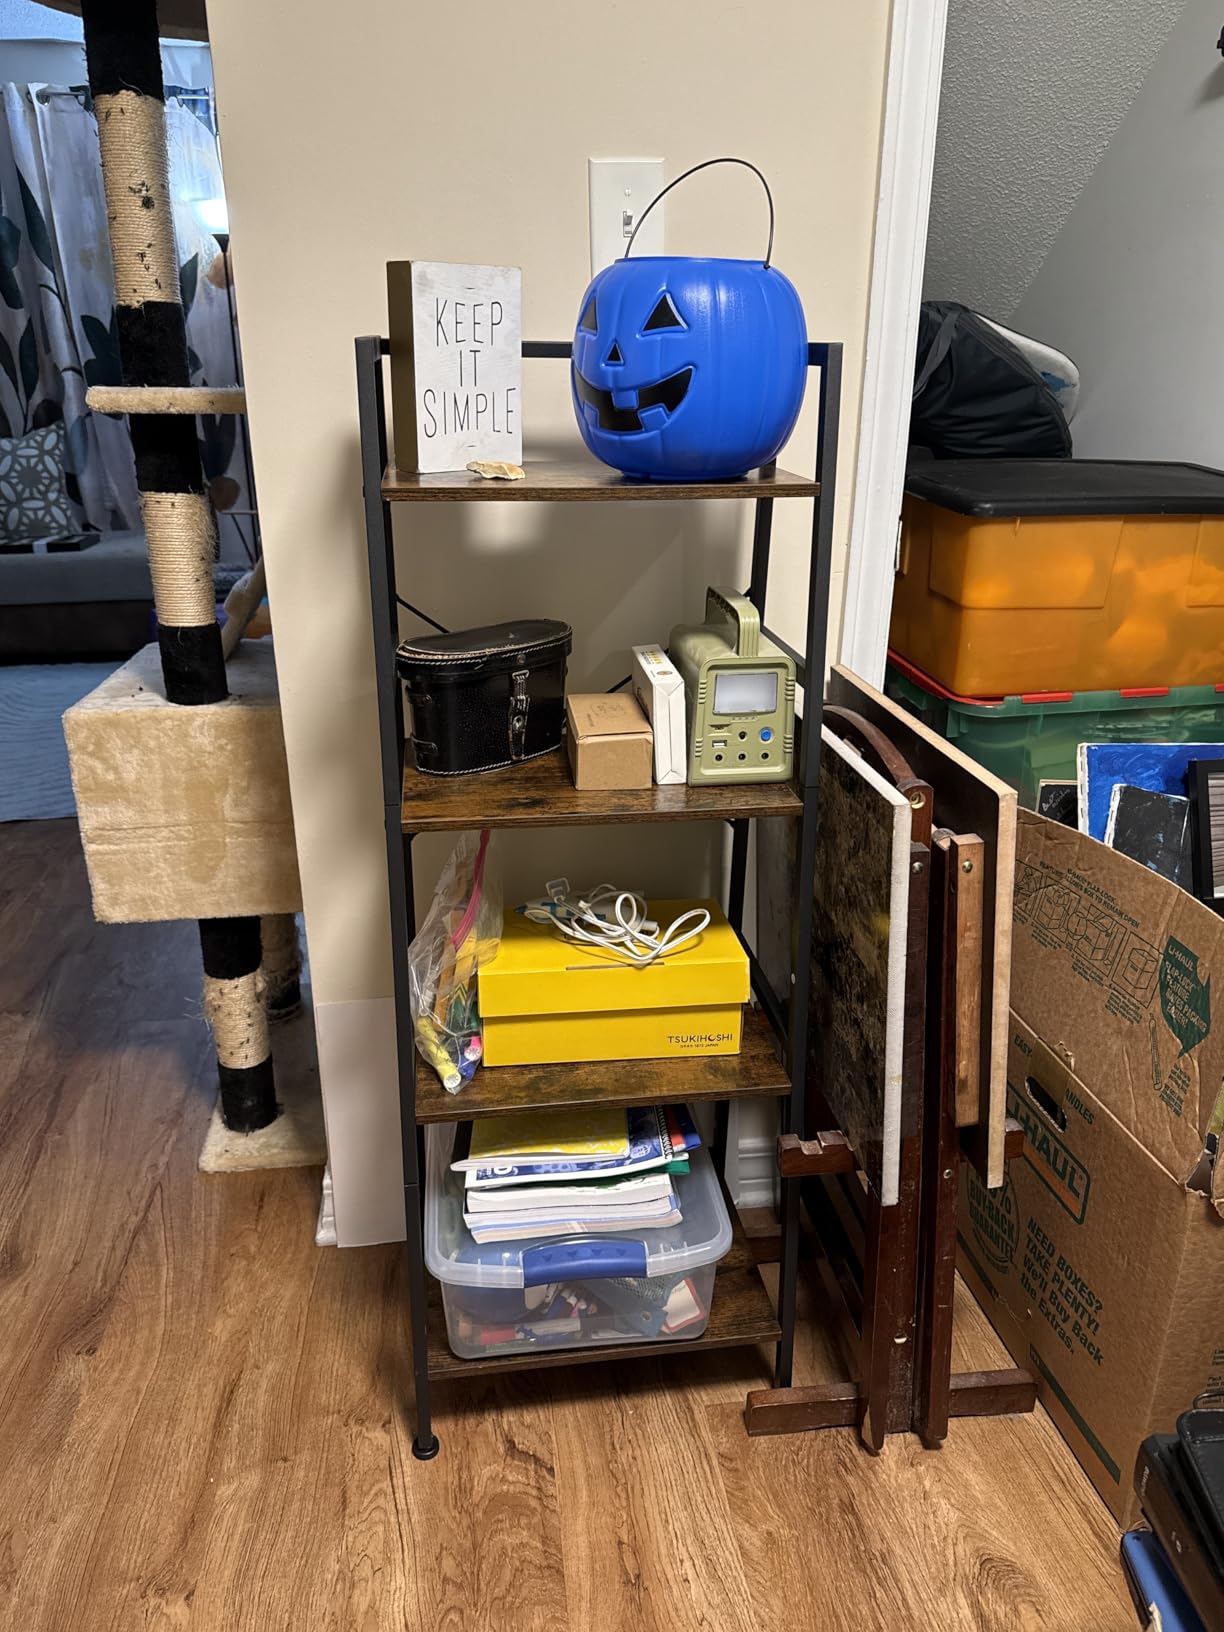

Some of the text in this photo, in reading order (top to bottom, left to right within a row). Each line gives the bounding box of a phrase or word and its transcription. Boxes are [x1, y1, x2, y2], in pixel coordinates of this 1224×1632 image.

[436, 297, 503, 347] KEEP
[459, 350, 481, 387] IT
[423, 387, 516, 438] SIMPLE
[1021, 1272, 1037, 1300] the
[1025, 1233, 1100, 1336] TAKE PLENTY!
[1027, 1216, 1103, 1314] NEED BOXES?
[1049, 1289, 1070, 1323] Buy
[1071, 1319, 1104, 1367] Back
